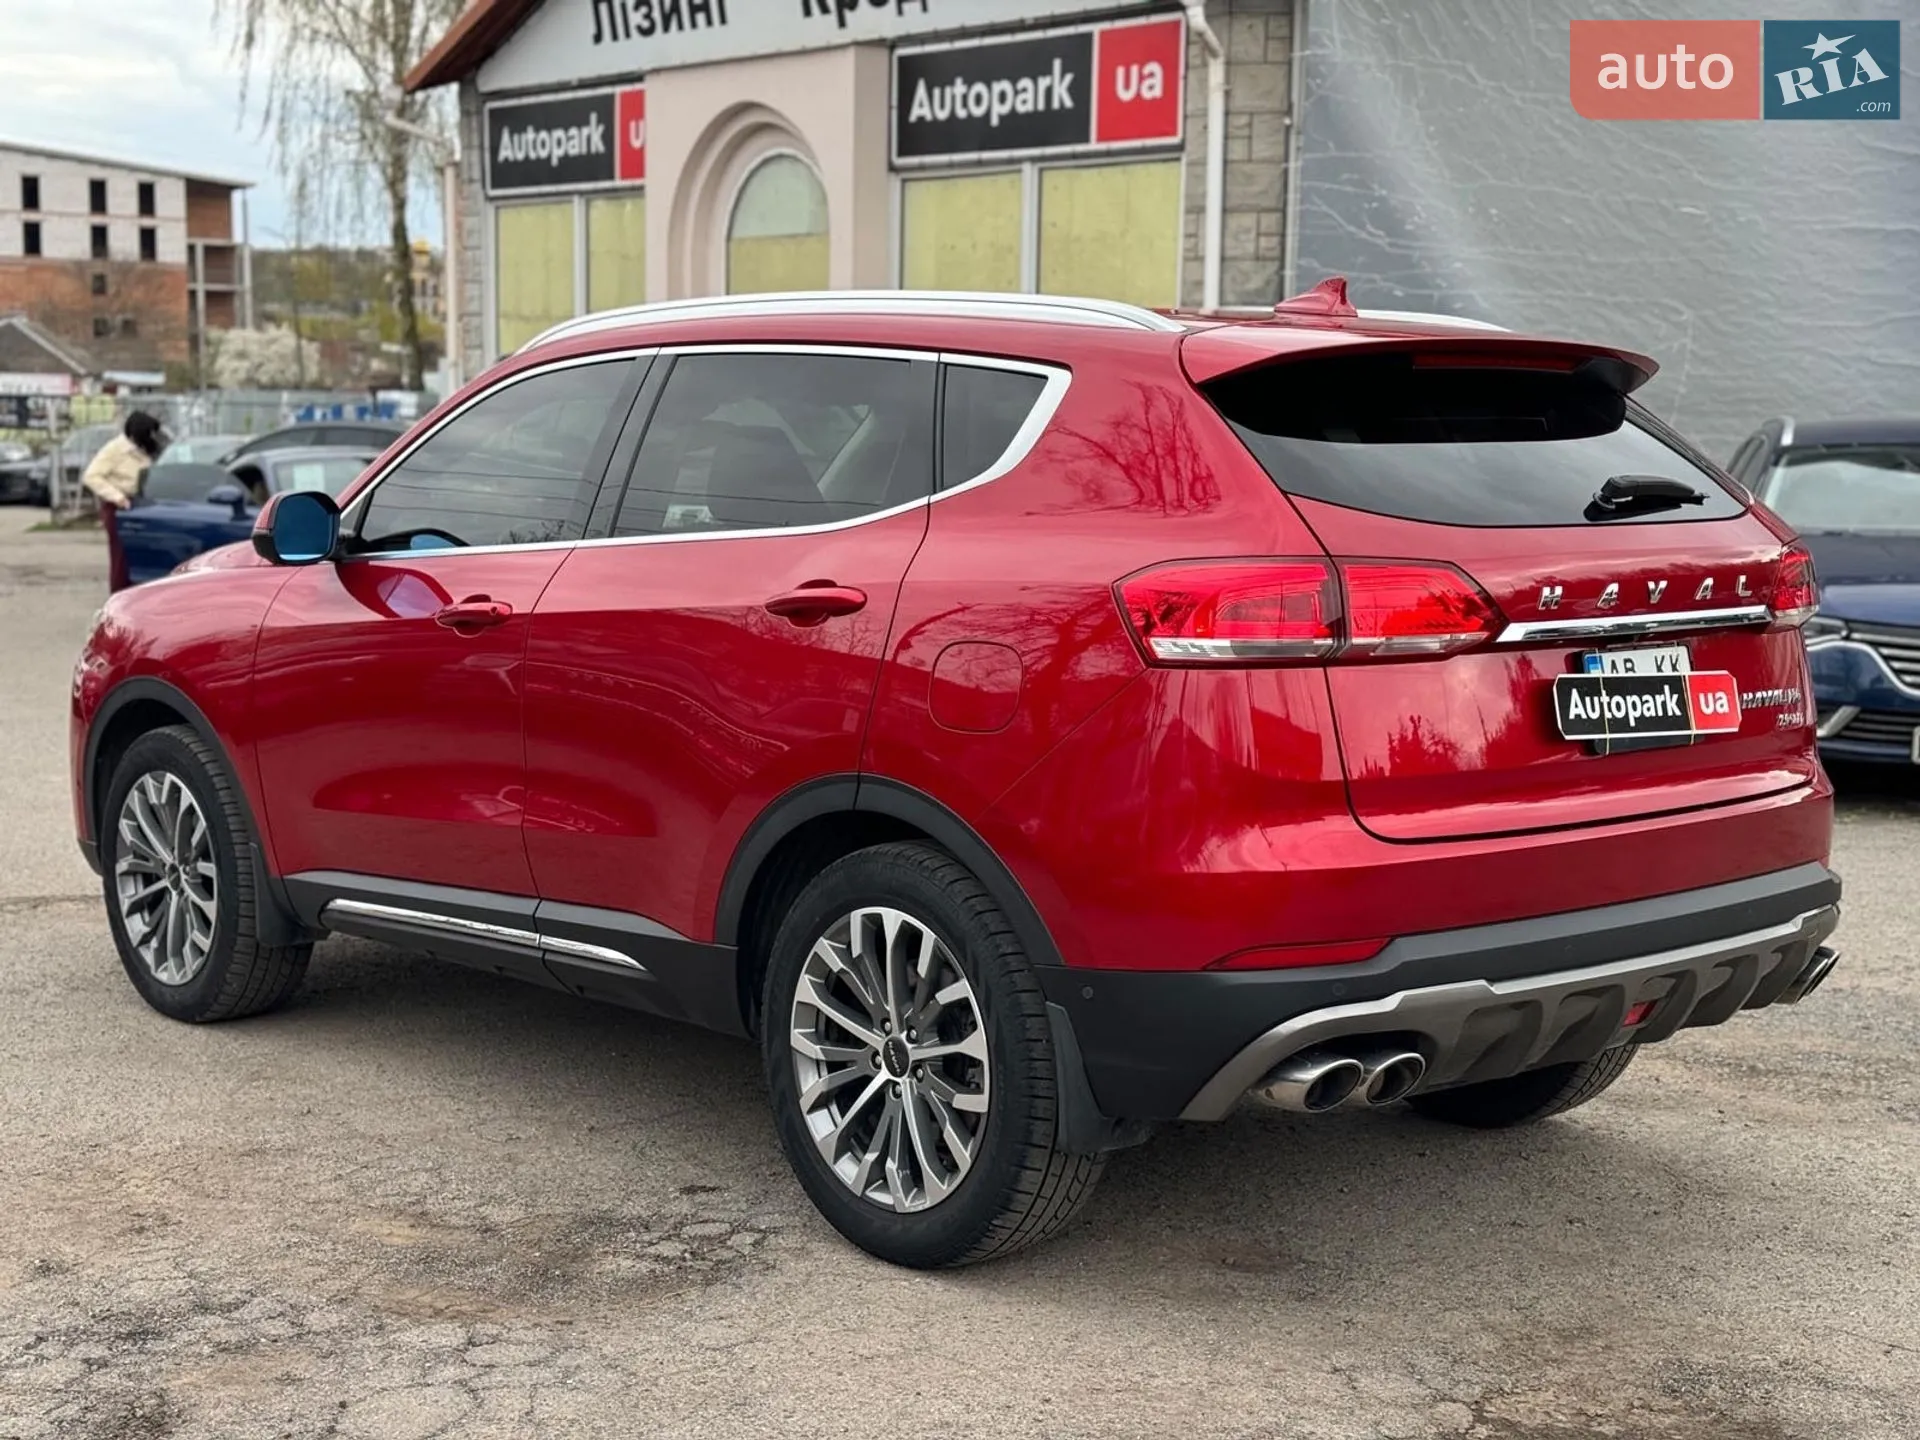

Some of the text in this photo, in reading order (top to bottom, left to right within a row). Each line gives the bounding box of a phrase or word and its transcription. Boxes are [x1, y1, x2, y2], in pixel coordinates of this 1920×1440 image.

[908, 57, 1164, 127] Autopark ua
[497, 111, 606, 167] Autopark
[1538, 575, 1753, 611] HAVAL
[1568, 684, 1729, 728] Autopark ua
